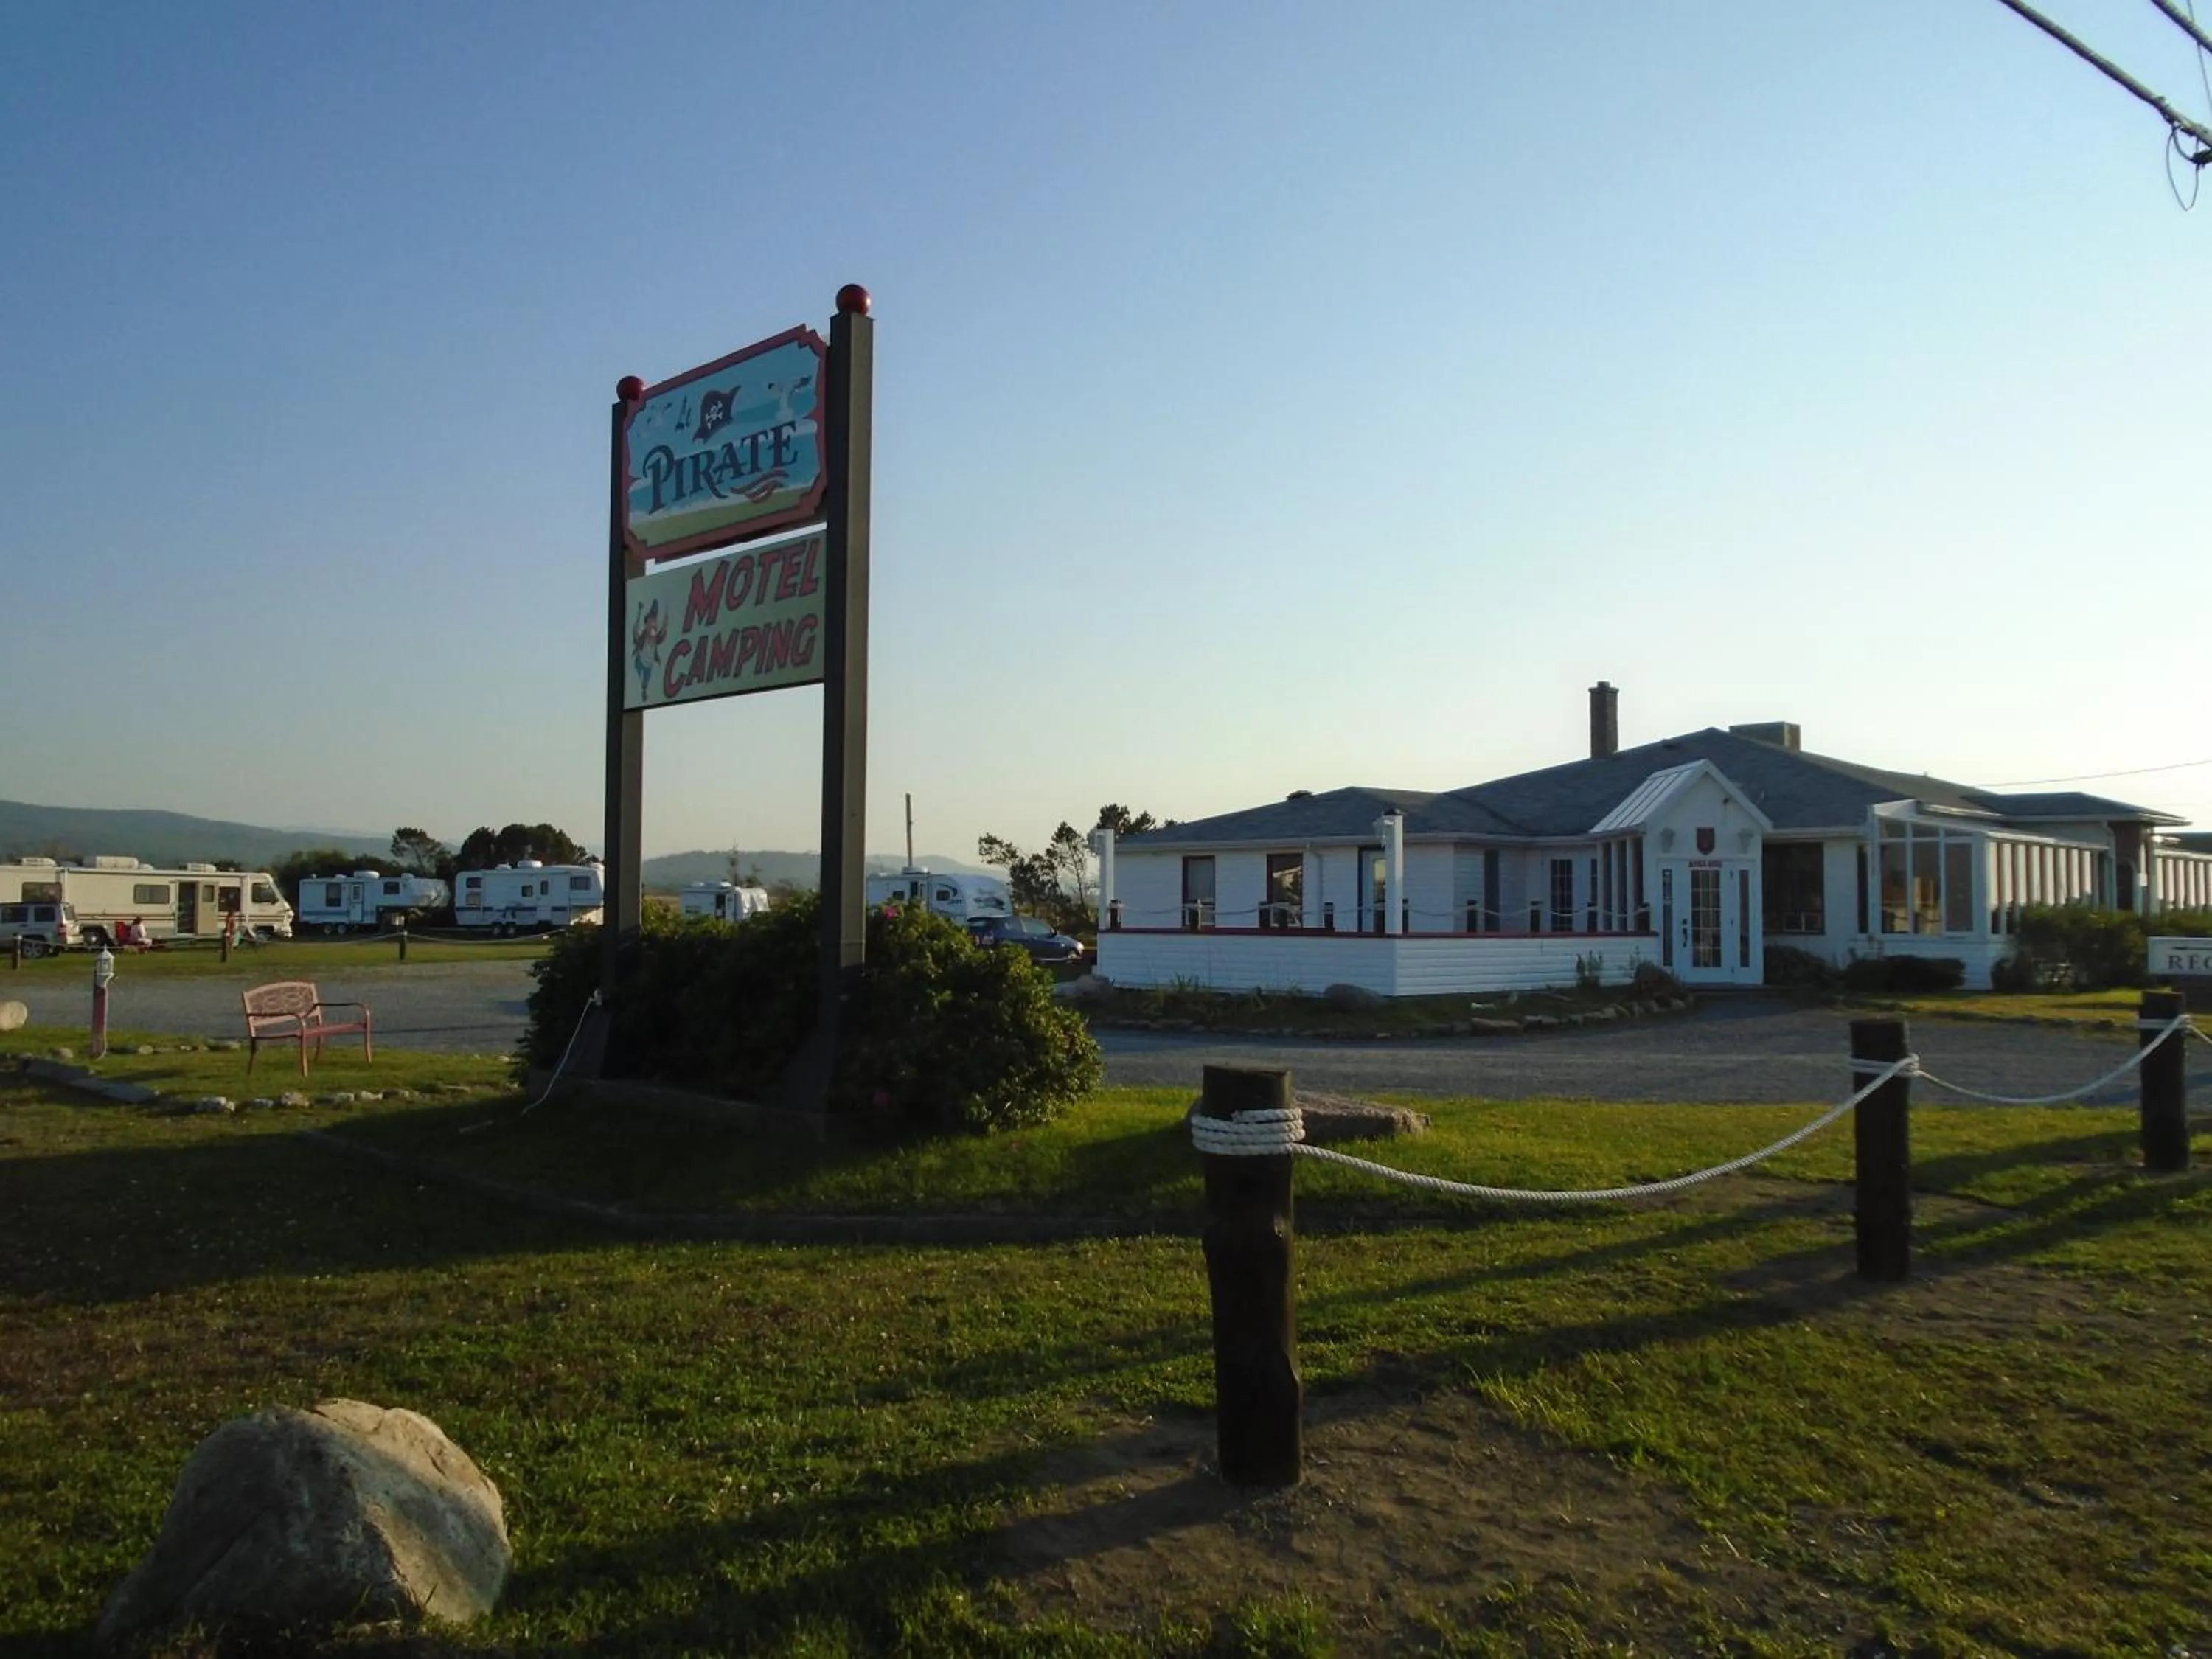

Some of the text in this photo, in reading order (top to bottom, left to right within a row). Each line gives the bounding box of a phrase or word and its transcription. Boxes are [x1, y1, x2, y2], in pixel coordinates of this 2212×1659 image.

[642, 420, 799, 515] PIRATE
[682, 538, 821, 634] MOTEL
[664, 613, 819, 698] CAMPING
